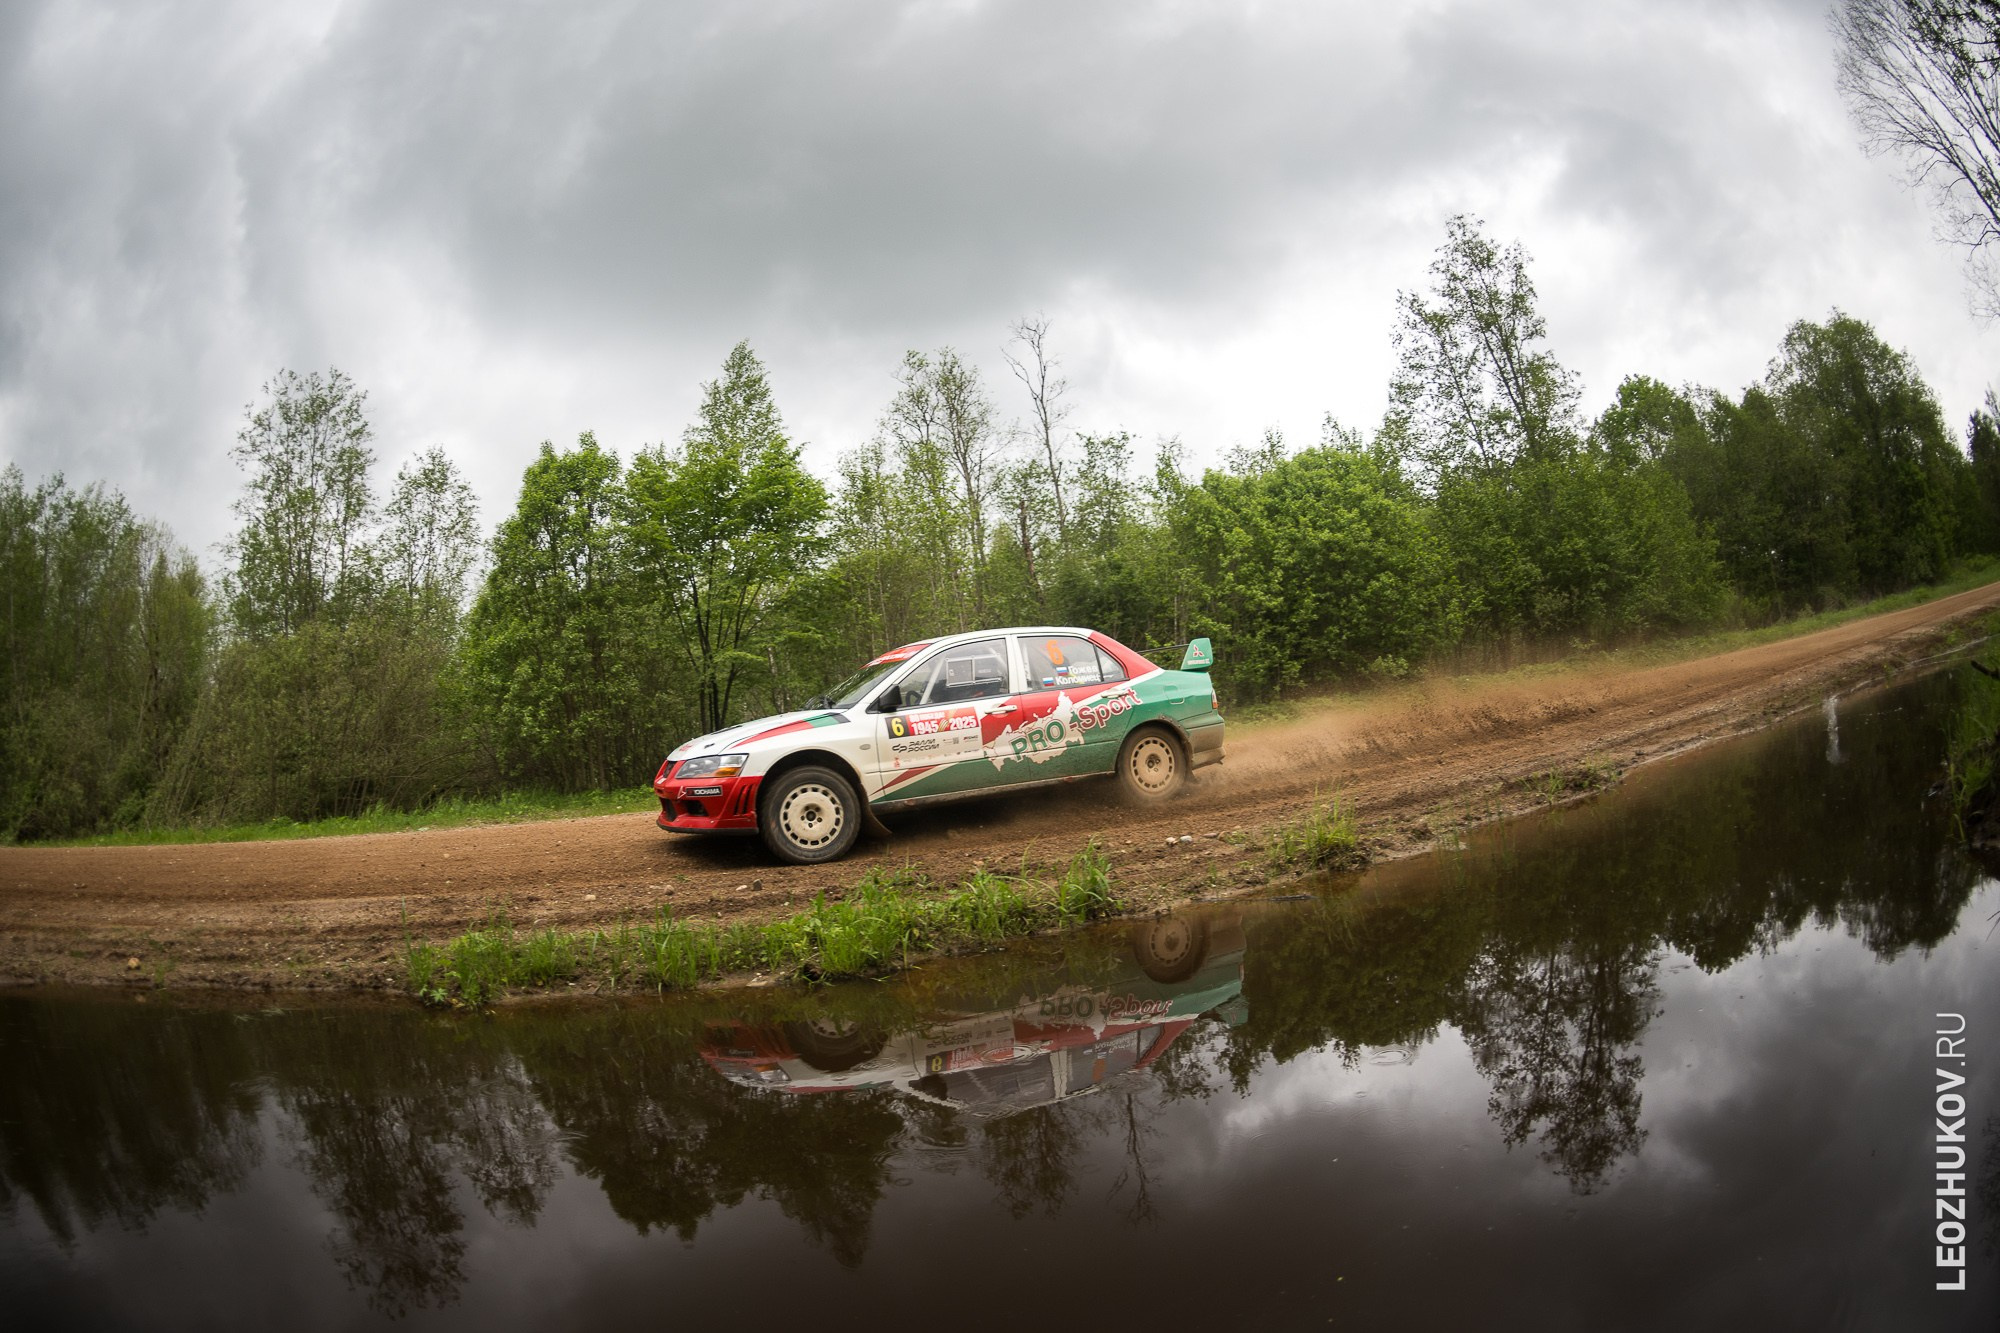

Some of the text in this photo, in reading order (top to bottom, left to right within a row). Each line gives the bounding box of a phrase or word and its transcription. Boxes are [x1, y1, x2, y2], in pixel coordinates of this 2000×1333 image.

[1046, 639, 1065, 666] 6
[890, 717, 905, 737] 6
[911, 720, 939, 736] 1945
[949, 715, 977, 731] 2025
